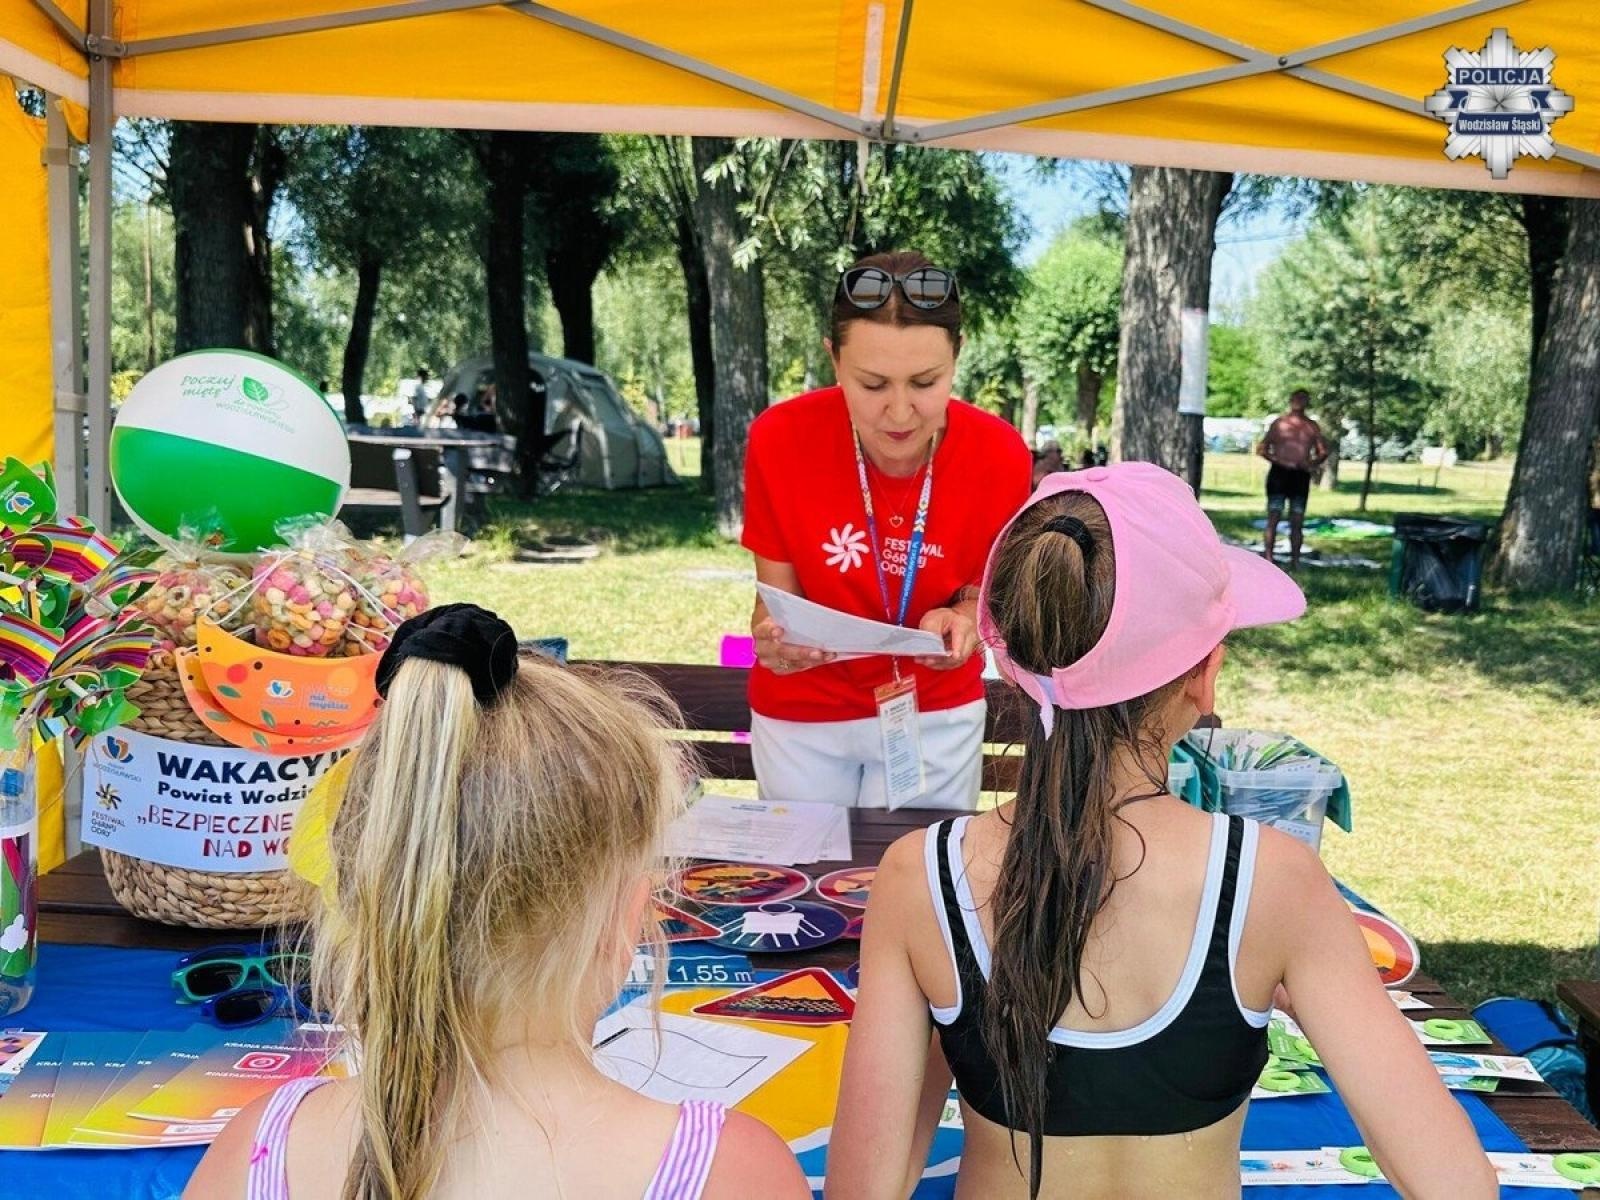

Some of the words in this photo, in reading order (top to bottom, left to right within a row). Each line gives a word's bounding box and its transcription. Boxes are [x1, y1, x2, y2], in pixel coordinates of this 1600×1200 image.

[884, 537, 945, 558] FESTWAL
[880, 560, 907, 577] ODR
[157, 747, 351, 784] WAKACYJ
[158, 781, 233, 804] Powiat
[240, 783, 313, 805] Wodzi
[203, 838, 253, 858] NAD
[676, 964, 729, 983] 1,55
[735, 970, 752, 982] m
